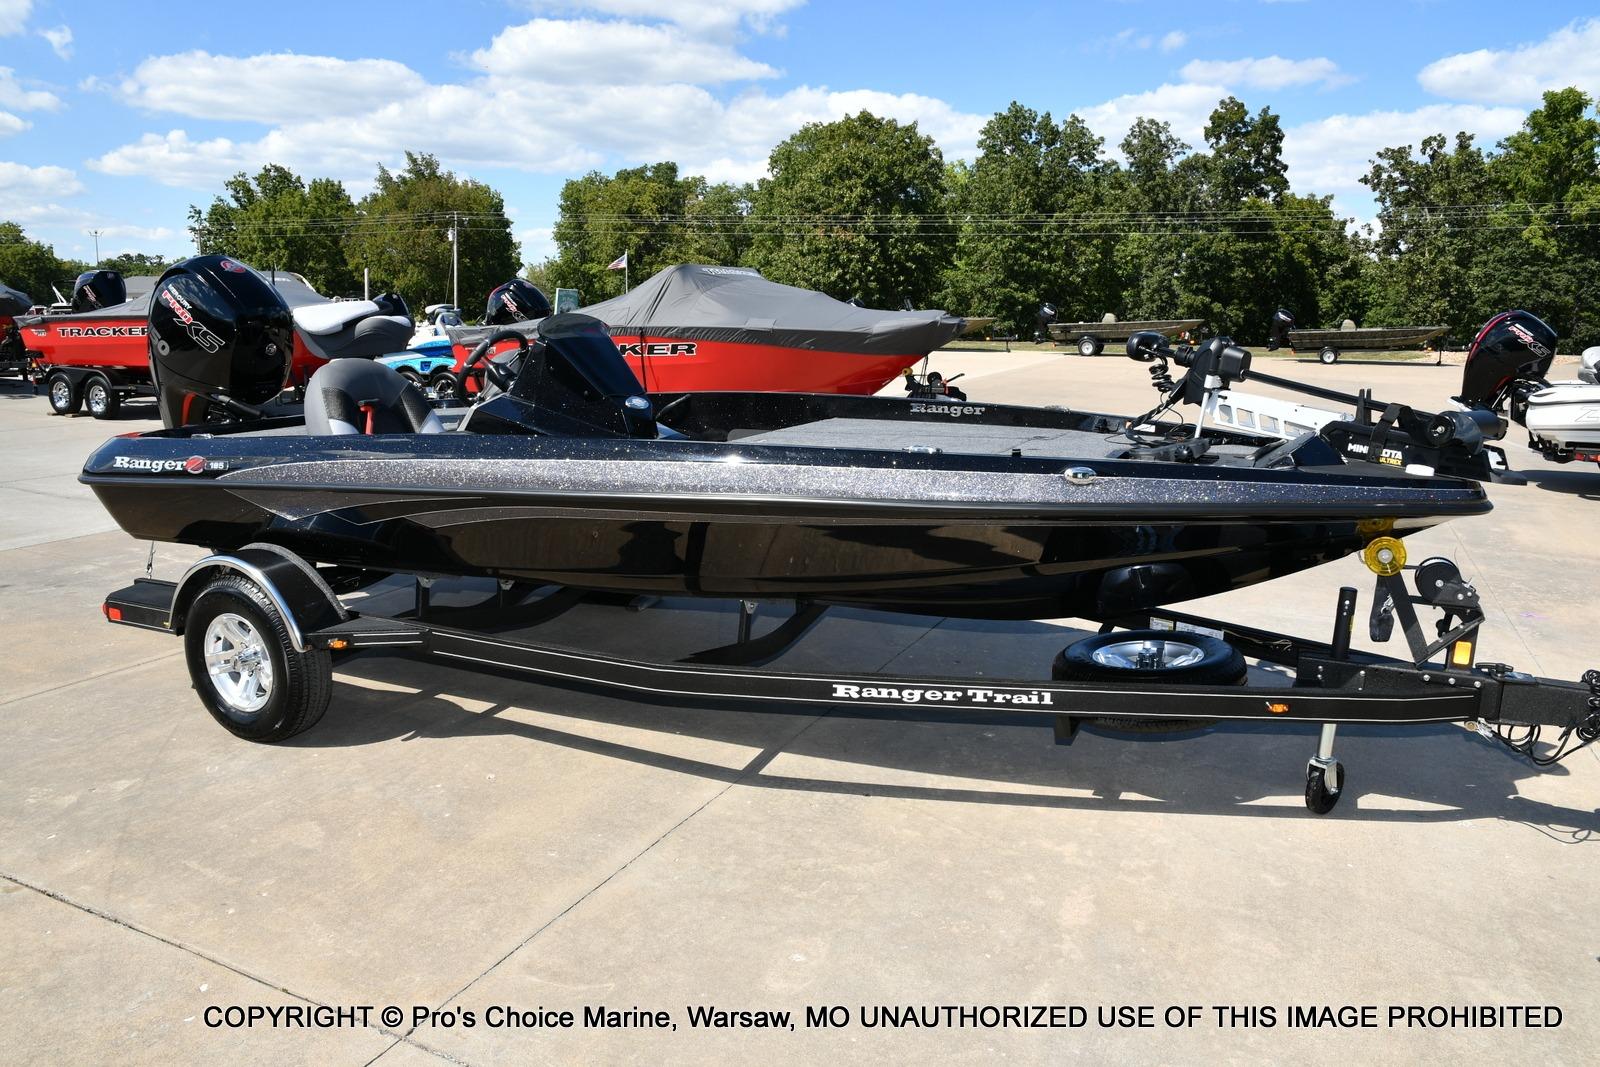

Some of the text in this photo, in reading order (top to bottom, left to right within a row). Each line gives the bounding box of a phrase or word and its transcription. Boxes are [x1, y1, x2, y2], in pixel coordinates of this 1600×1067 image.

[167, 283, 193, 310] MERCURY
[172, 317, 226, 354] XS
[618, 341, 698, 357] KER
[910, 402, 986, 418] Ranger
[1380, 449, 1403, 460] OTA
[113, 455, 187, 473] Ranger
[832, 684, 1054, 705] Ranger Trail
